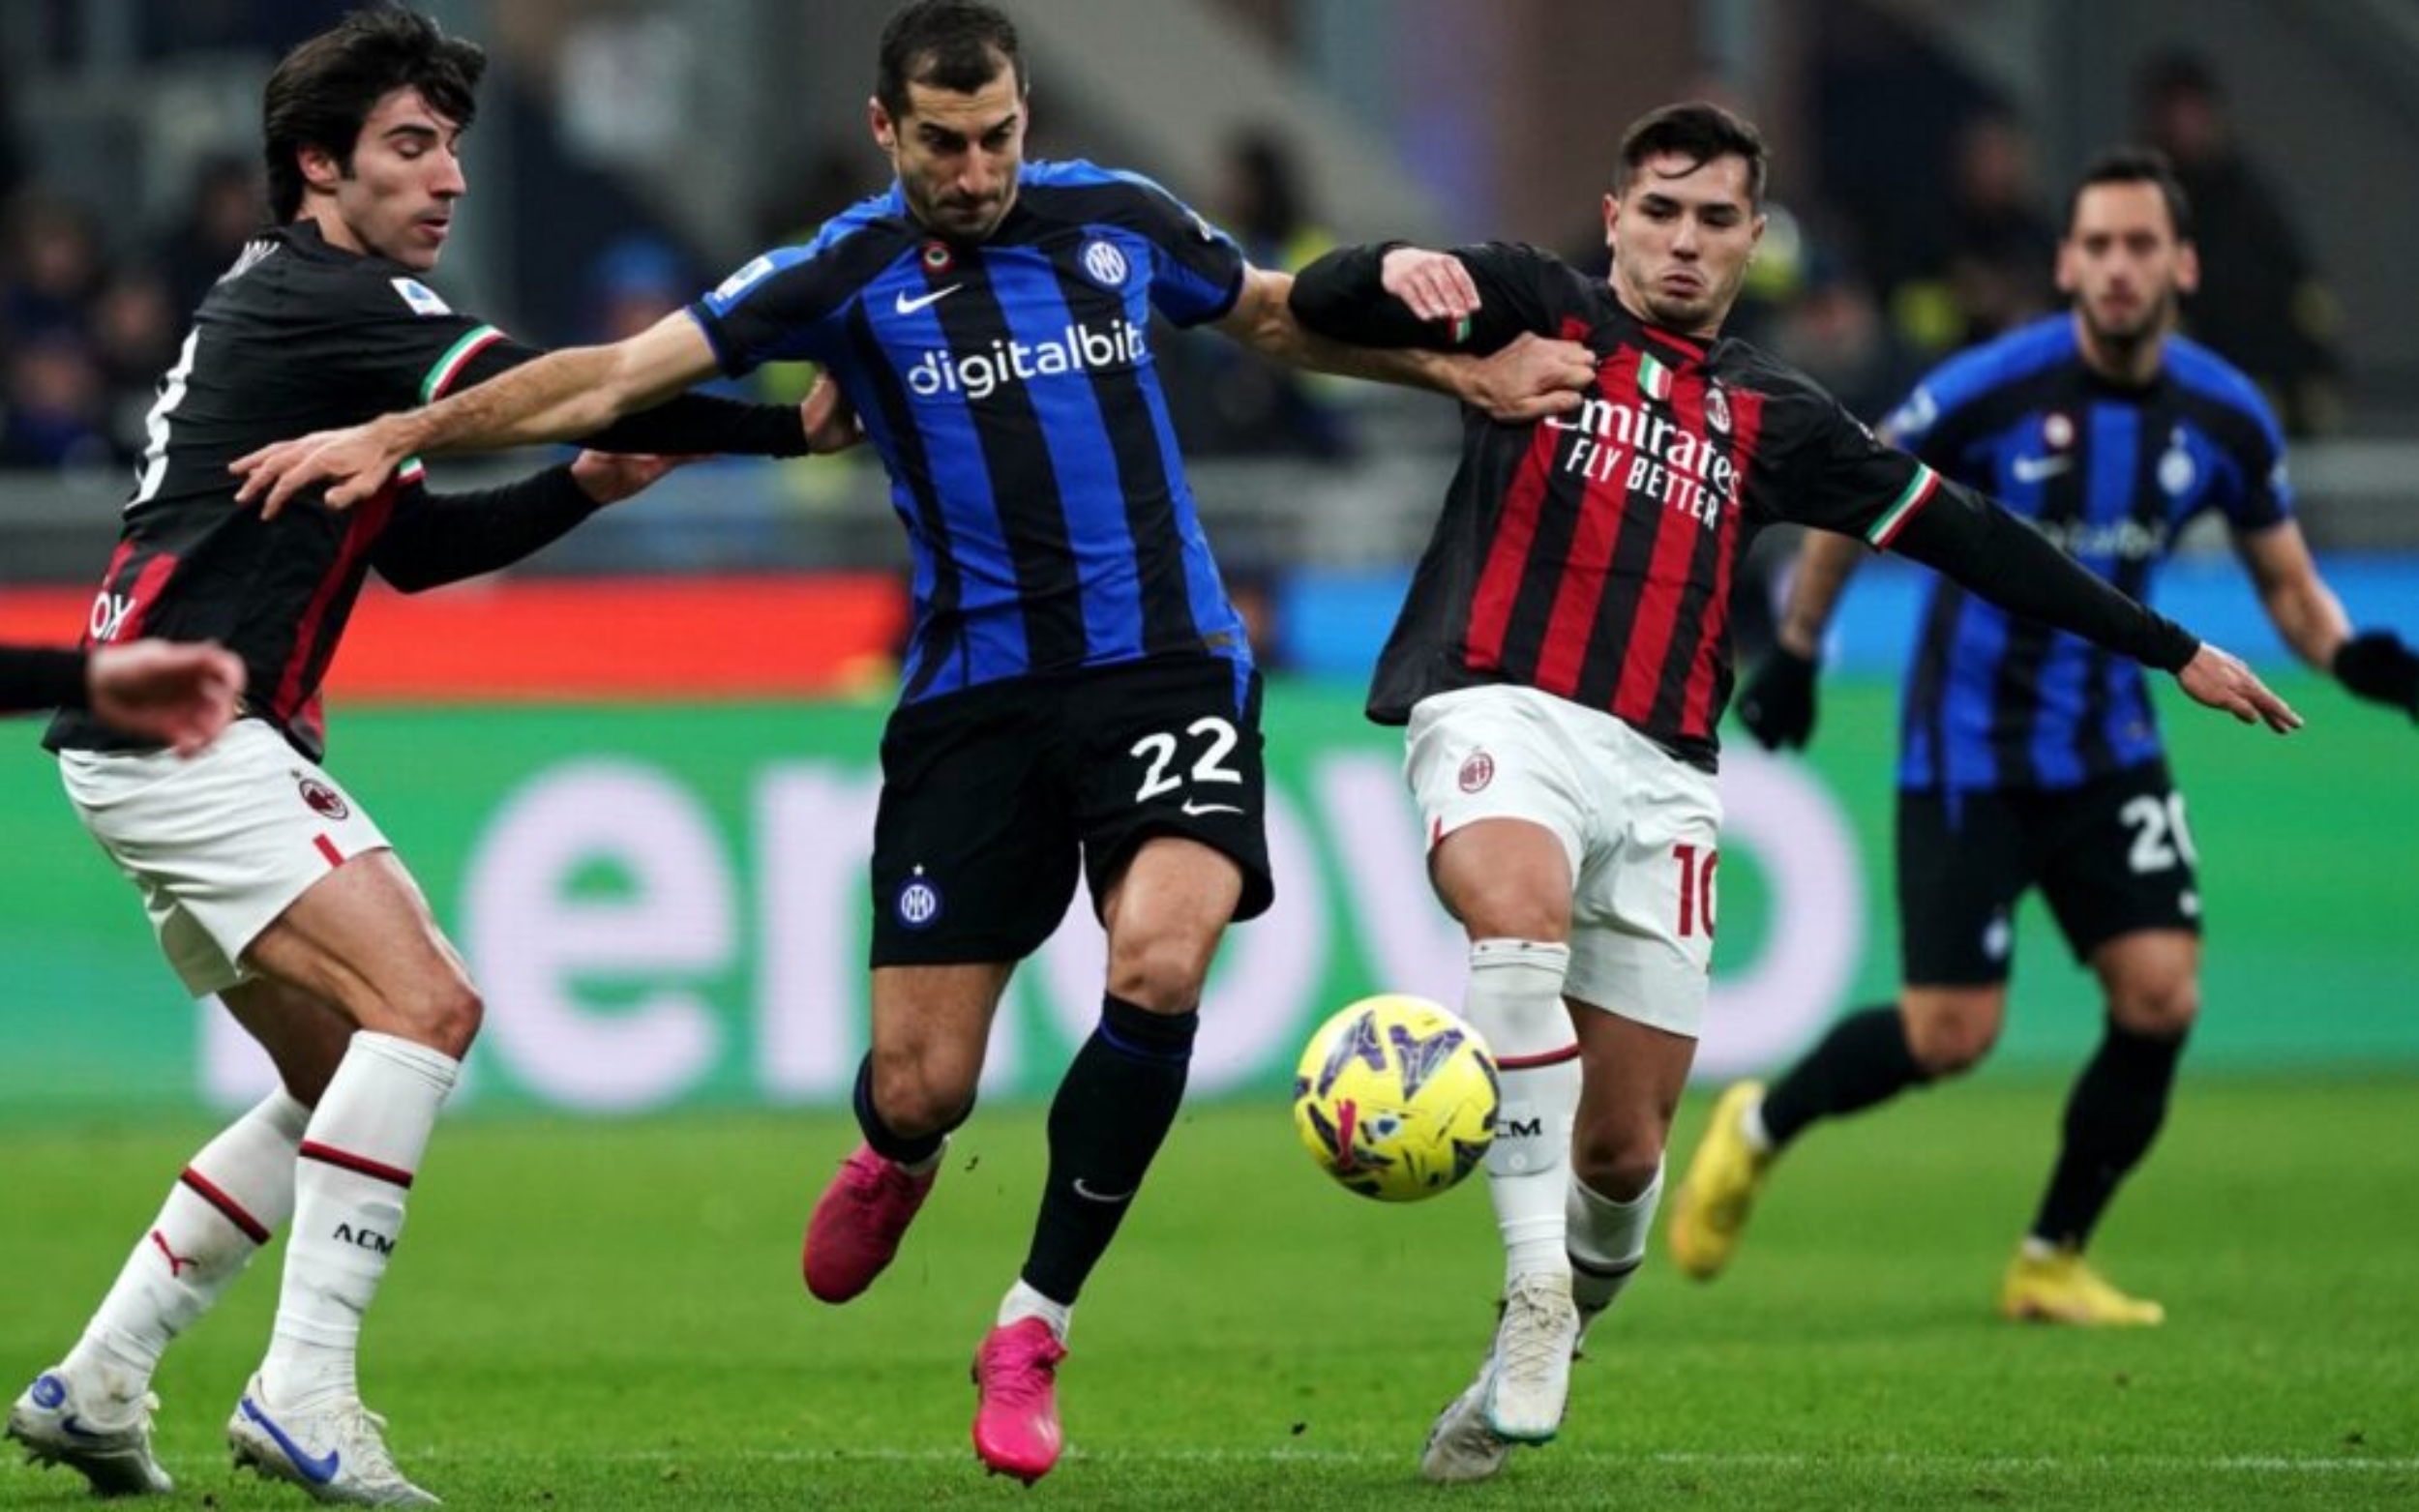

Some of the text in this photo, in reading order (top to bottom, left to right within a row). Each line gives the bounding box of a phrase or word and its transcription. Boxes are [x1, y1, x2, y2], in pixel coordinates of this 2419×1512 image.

[908, 319, 1146, 399] digitalbit
[1544, 399, 1742, 506] mirates
[1565, 437, 1719, 530] FLY BETTER
[1130, 715, 1242, 804] 22
[1493, 1117, 1542, 1138] CM
[332, 1222, 396, 1257] ACM
